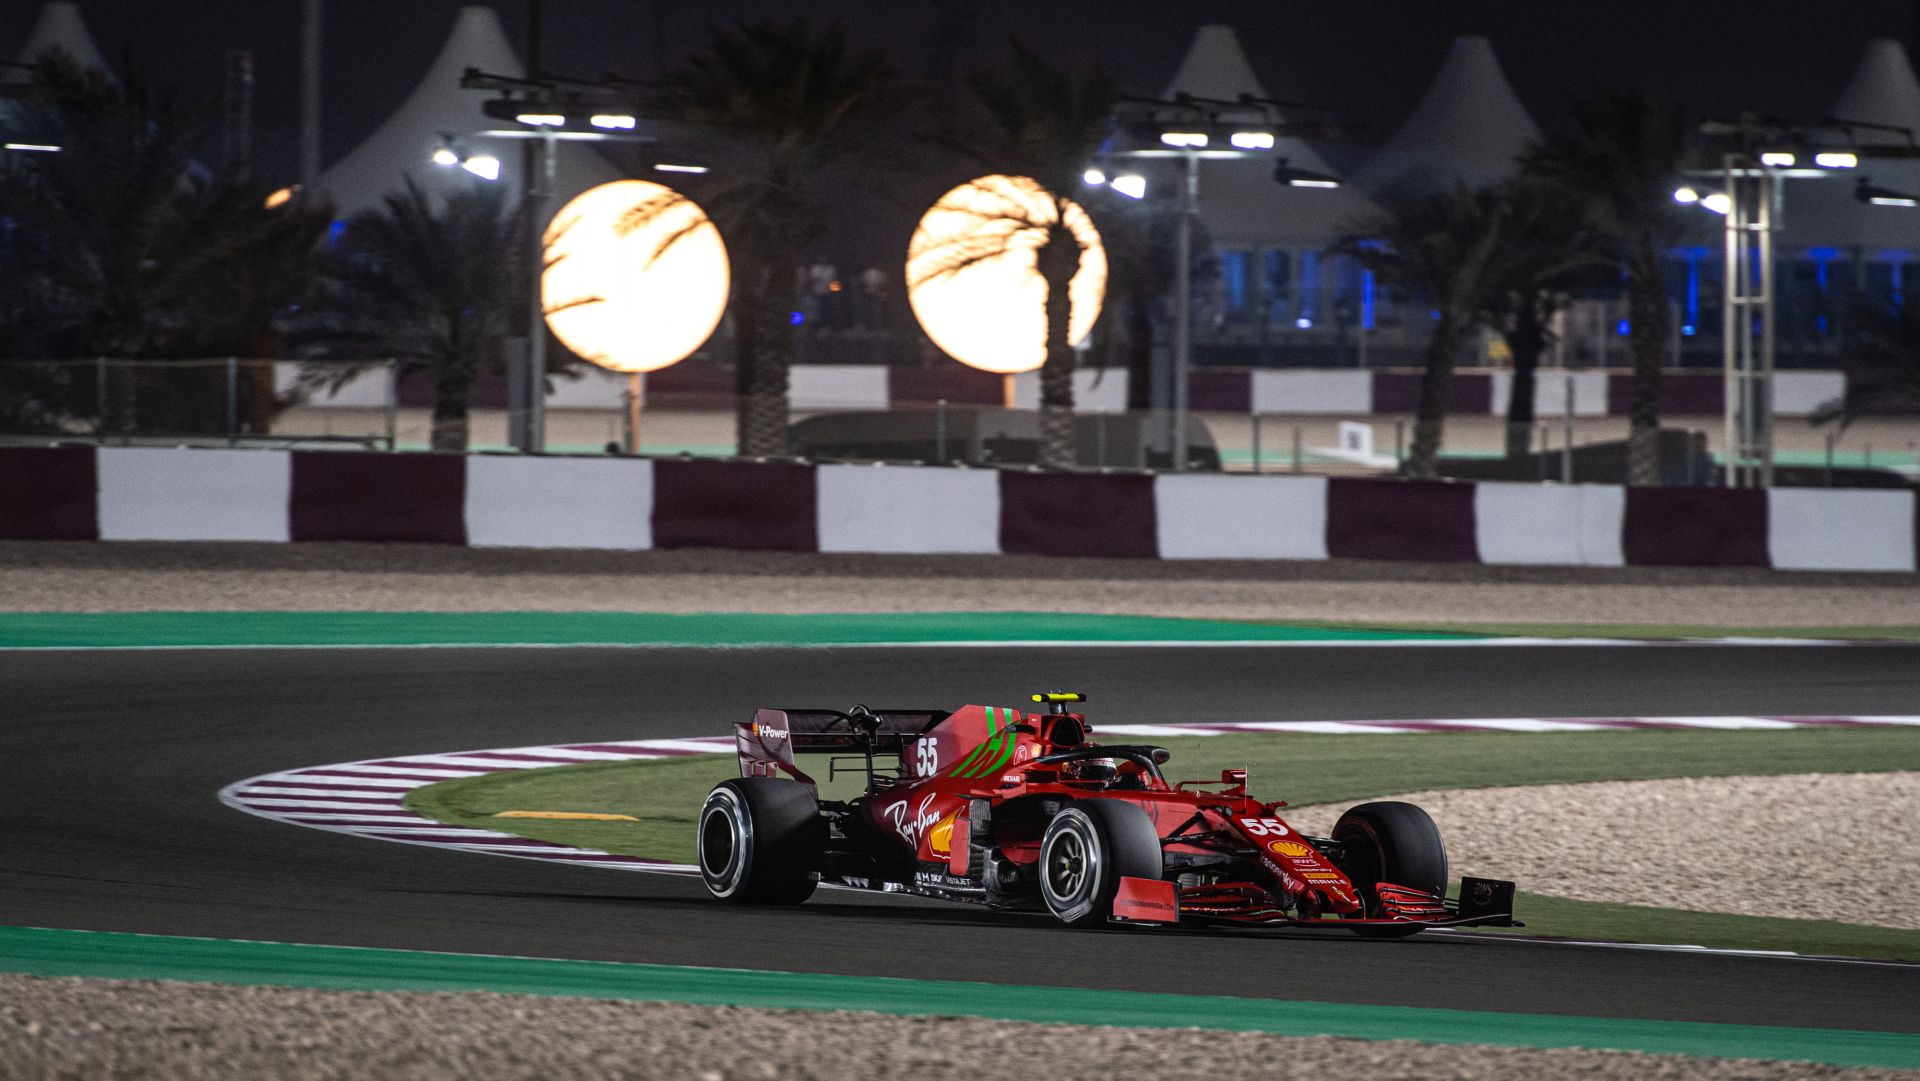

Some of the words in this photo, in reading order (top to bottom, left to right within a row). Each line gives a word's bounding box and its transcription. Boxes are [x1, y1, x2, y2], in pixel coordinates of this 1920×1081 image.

[758, 724, 789, 739] V-Power
[916, 736, 938, 777] 55
[1240, 818, 1289, 836] 55
